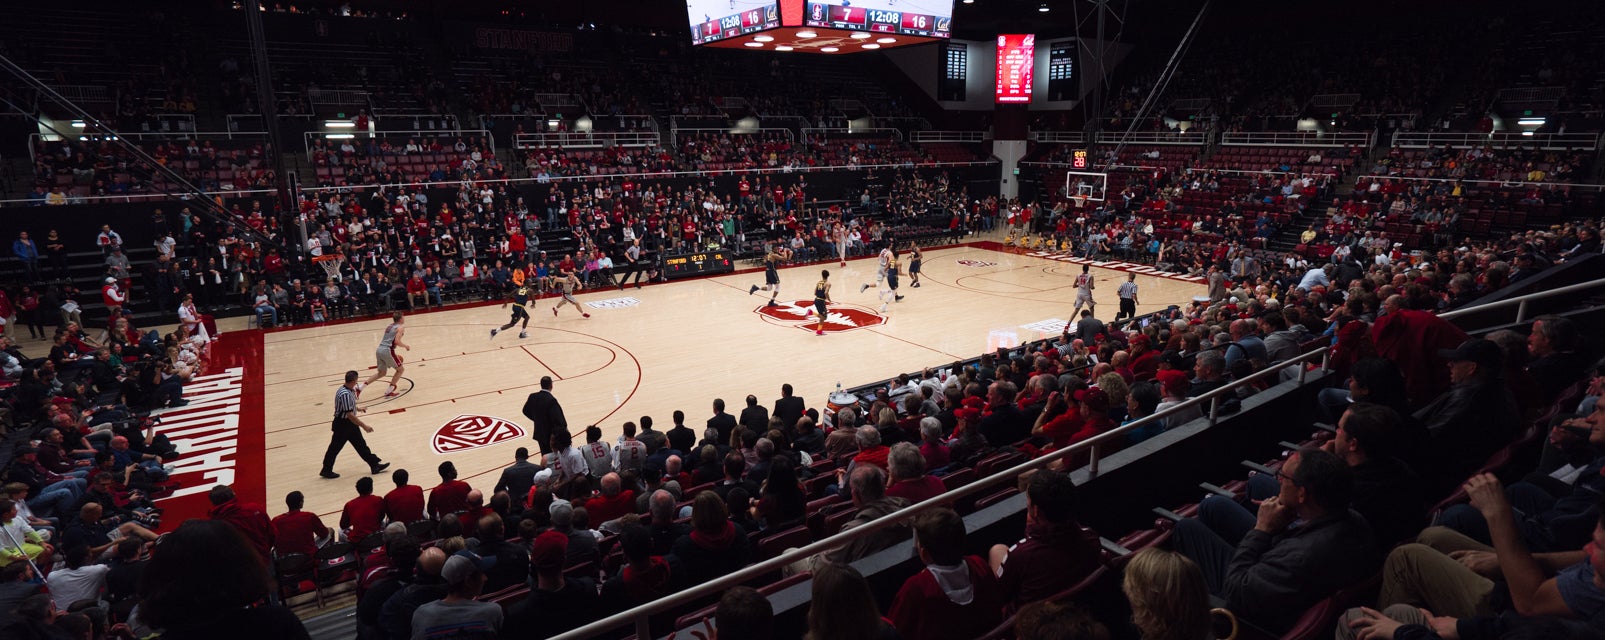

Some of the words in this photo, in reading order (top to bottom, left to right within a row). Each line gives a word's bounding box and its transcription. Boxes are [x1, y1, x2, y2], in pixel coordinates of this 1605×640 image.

[748, 11, 759, 25] 16
[843, 8, 852, 21] 7
[869, 10, 899, 24] 12:08
[721, 15, 741, 29] 12:08
[912, 15, 926, 28] 16
[937, 18, 951, 30] Cal
[707, 23, 713, 35] 7
[474, 27, 575, 51] STANFORD
[1074, 157, 1085, 167] 28
[592, 446, 605, 459] 15
[631, 447, 639, 459] 2
